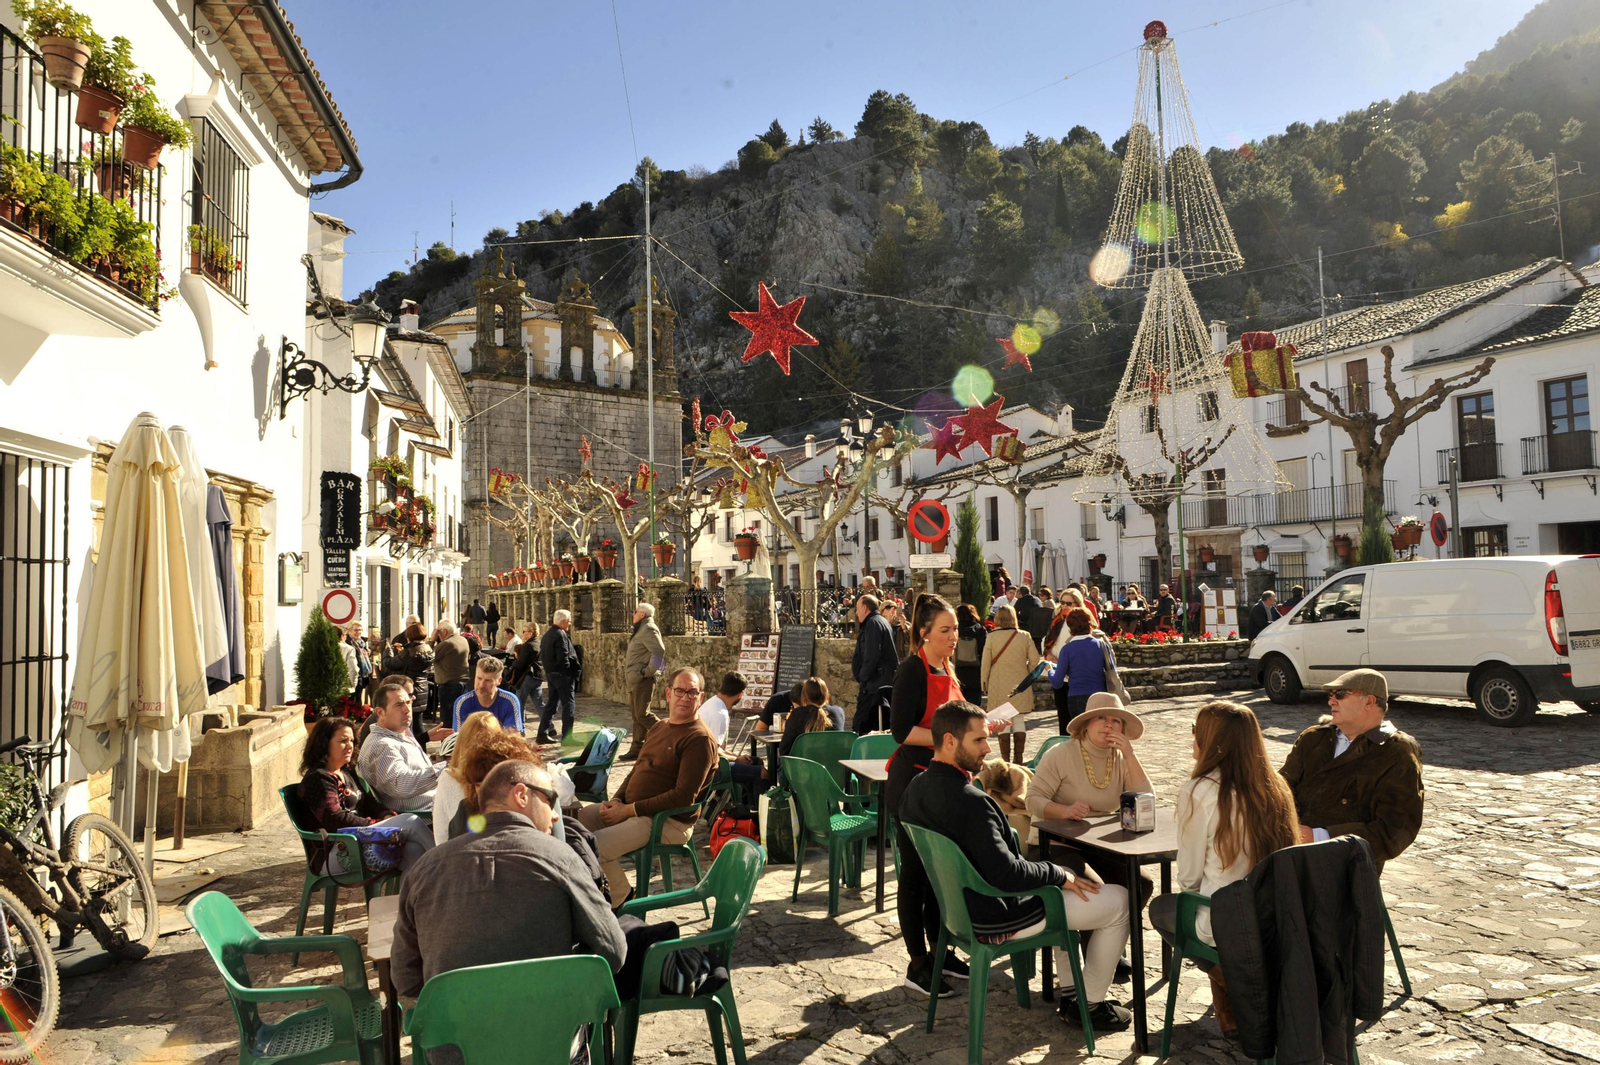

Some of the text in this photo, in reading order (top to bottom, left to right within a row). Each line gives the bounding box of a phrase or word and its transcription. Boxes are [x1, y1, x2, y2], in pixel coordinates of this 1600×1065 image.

[327, 479, 354, 490] BAR
[336, 488, 344, 543] GRAZALEMA
[327, 535, 354, 543] PLAZA
